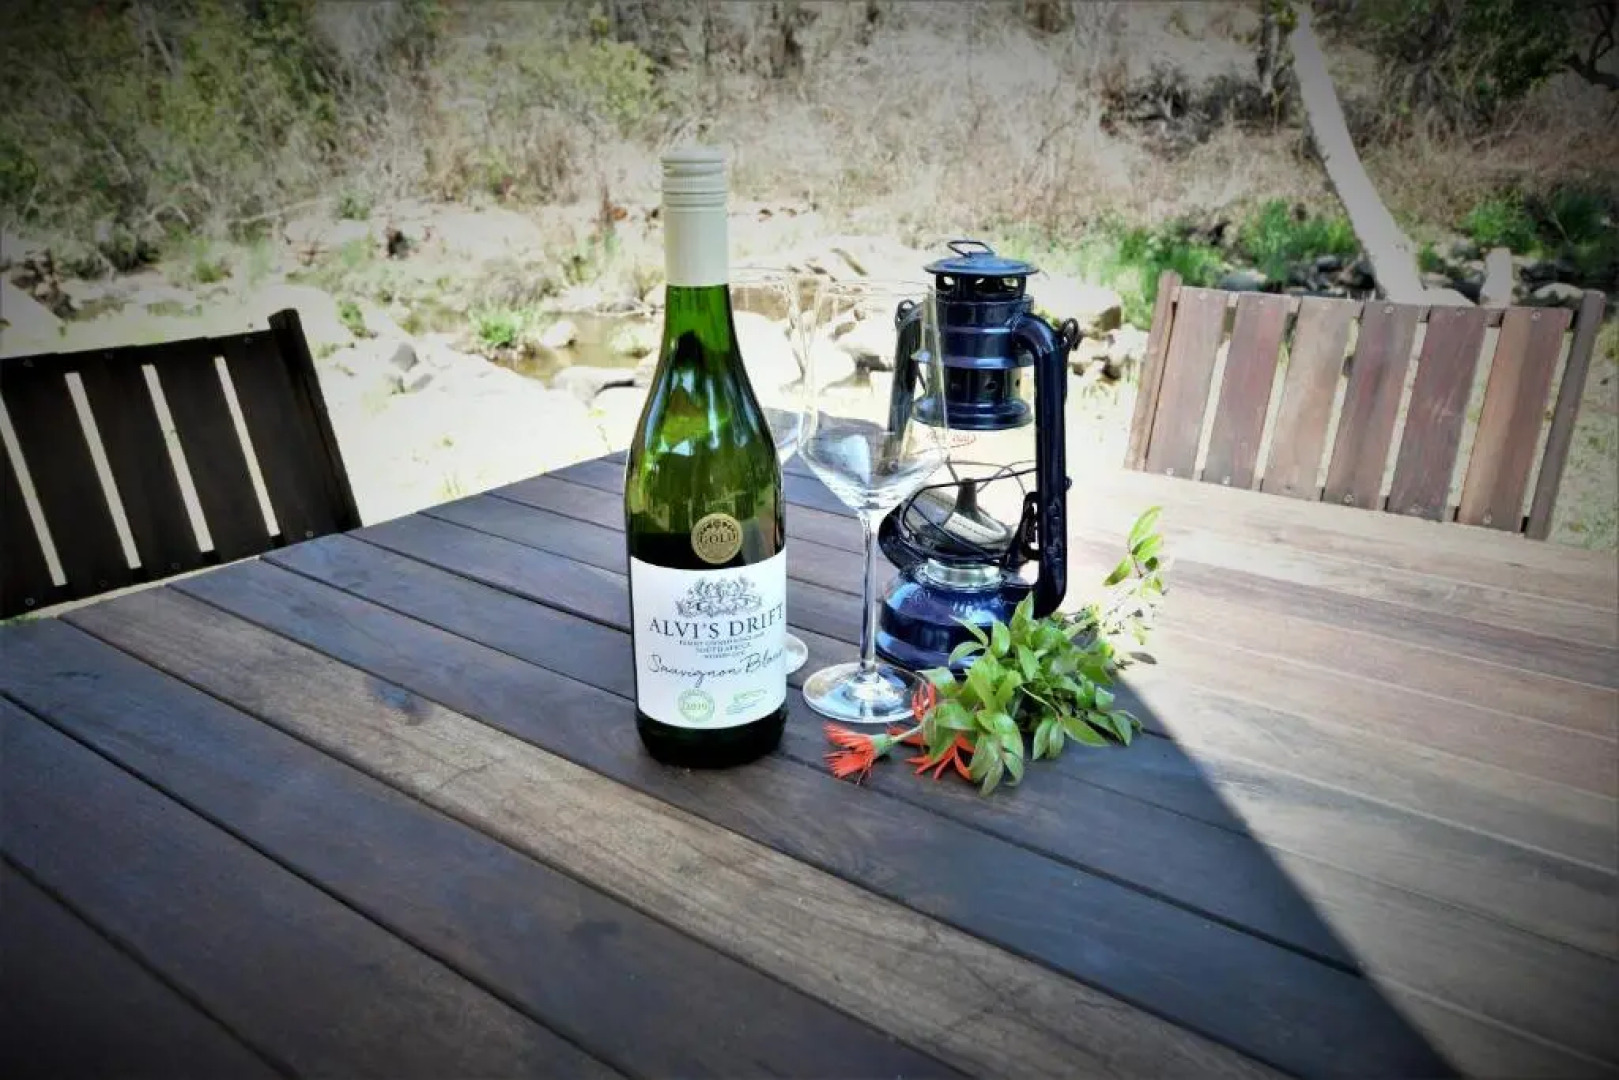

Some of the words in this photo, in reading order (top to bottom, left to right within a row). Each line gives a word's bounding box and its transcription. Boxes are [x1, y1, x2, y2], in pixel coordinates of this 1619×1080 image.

[700, 533, 736, 545] GOLD
[649, 617, 720, 639] ALVI'S
[729, 602, 783, 637] DRIFT
[647, 652, 741, 689] Sauvignon
